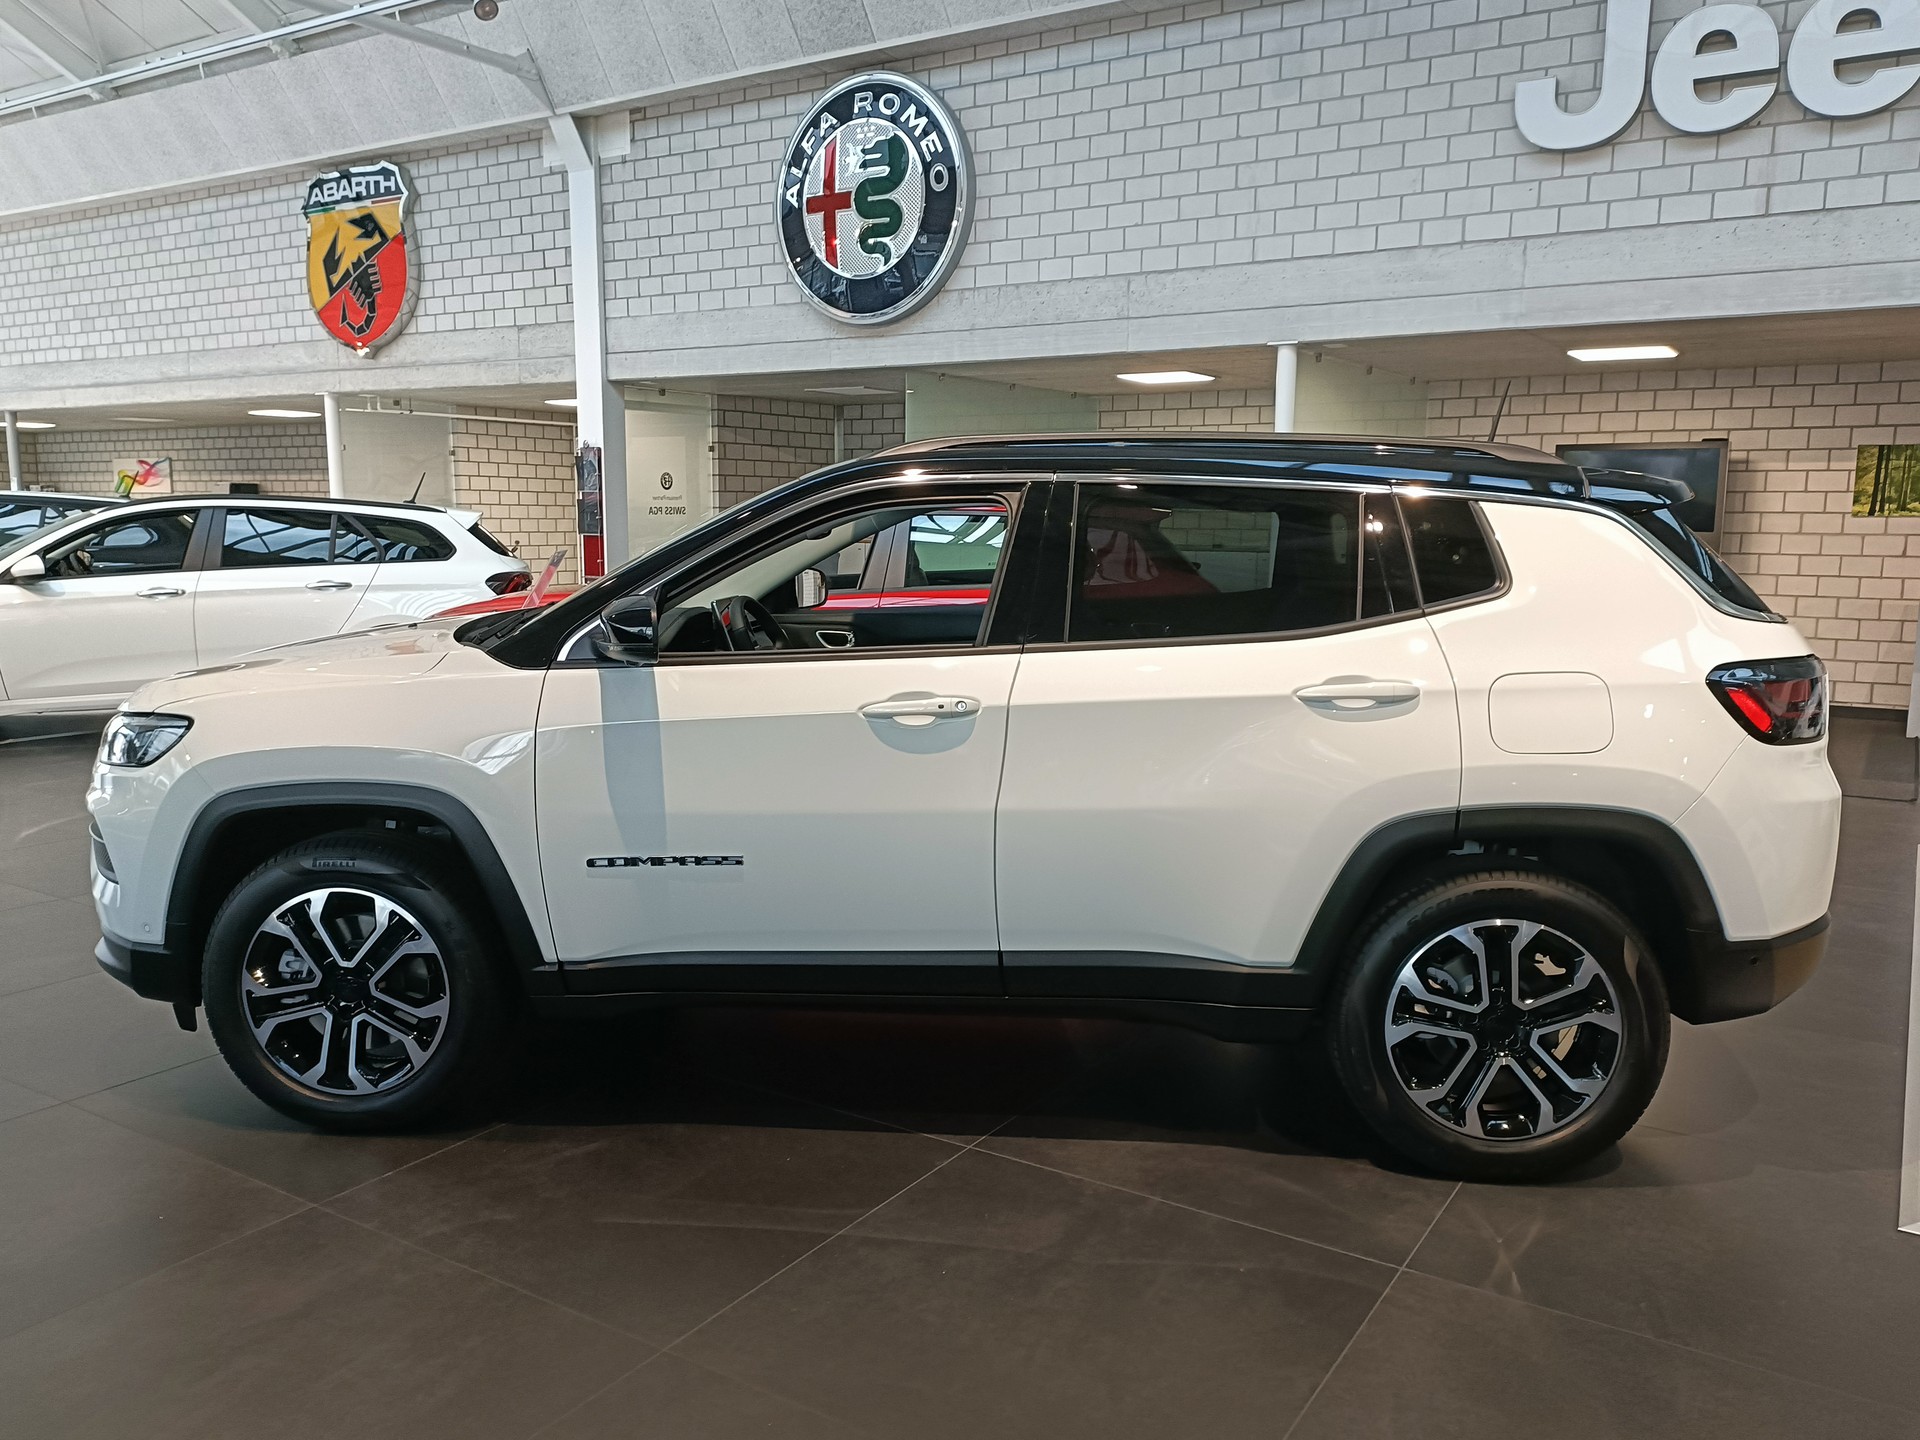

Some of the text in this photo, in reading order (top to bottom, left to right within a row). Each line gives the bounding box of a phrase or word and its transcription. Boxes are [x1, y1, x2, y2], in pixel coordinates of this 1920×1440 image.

[785, 91, 950, 209] ALFA ROMEO
[309, 175, 396, 205] ABARTH
[312, 857, 357, 868] PIRELLI
[586, 855, 744, 868] COMPASS
